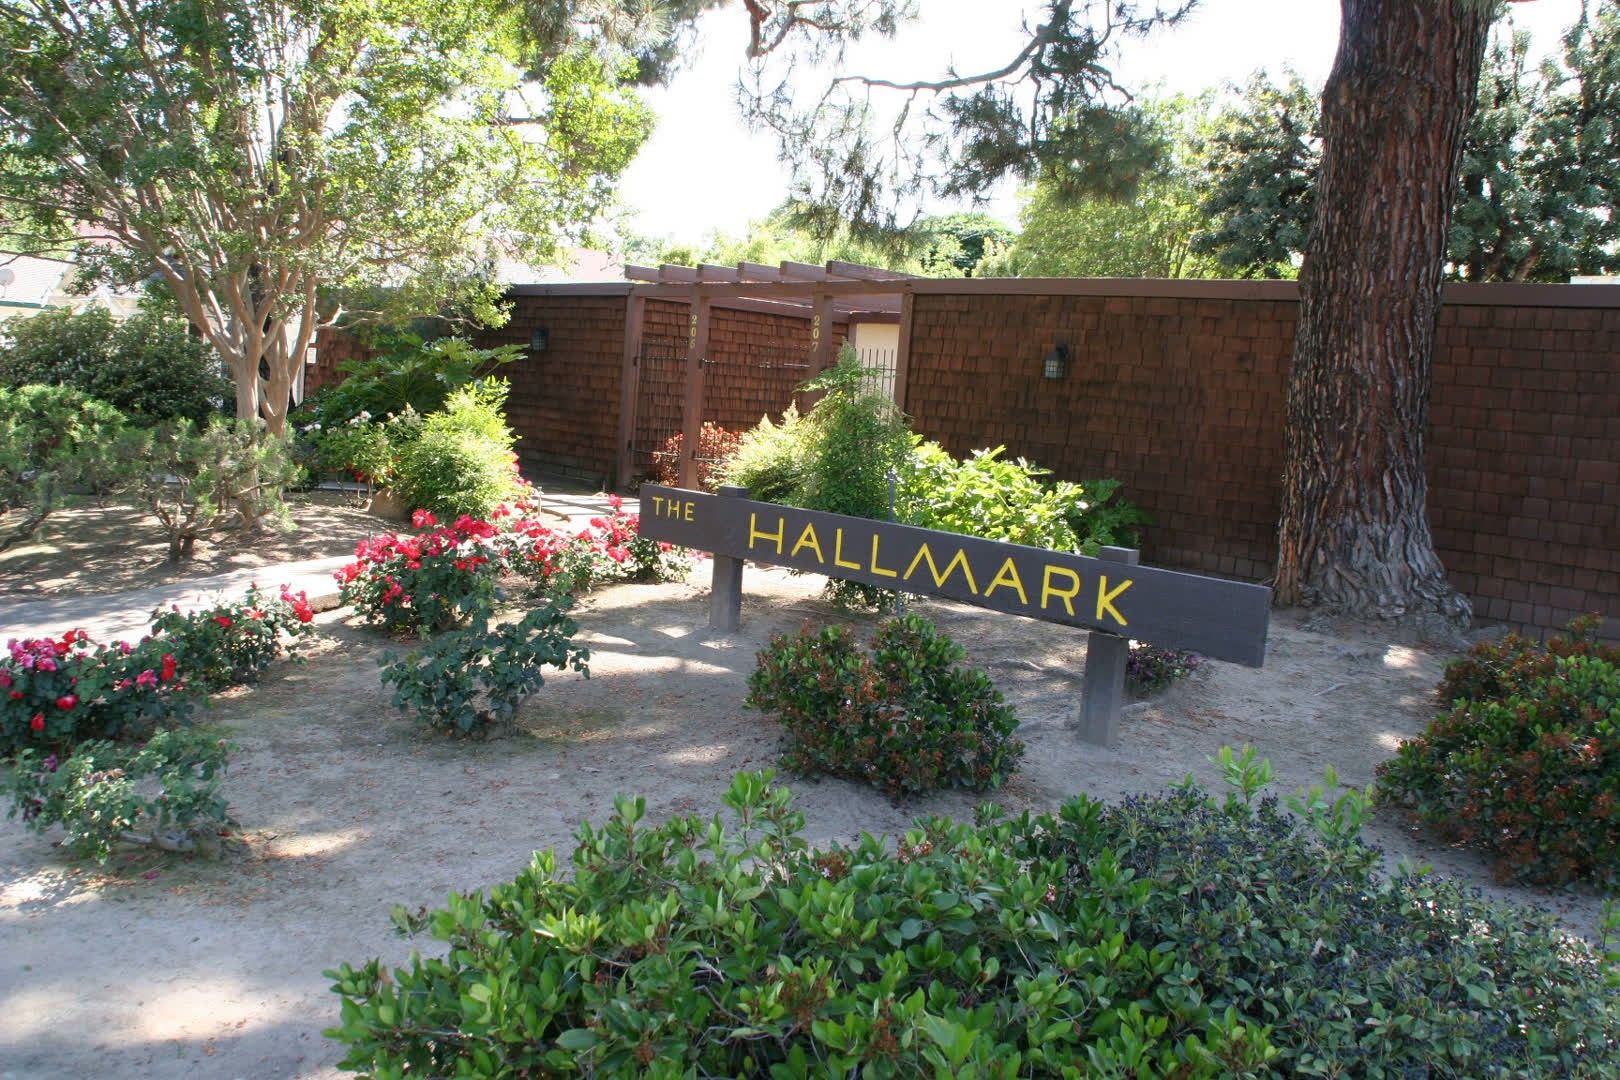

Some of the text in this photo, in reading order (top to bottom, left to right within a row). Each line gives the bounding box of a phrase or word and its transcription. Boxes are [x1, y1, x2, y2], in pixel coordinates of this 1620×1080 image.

[811, 314, 821, 352] 207
[651, 496, 1134, 626] THE HALLMARK
